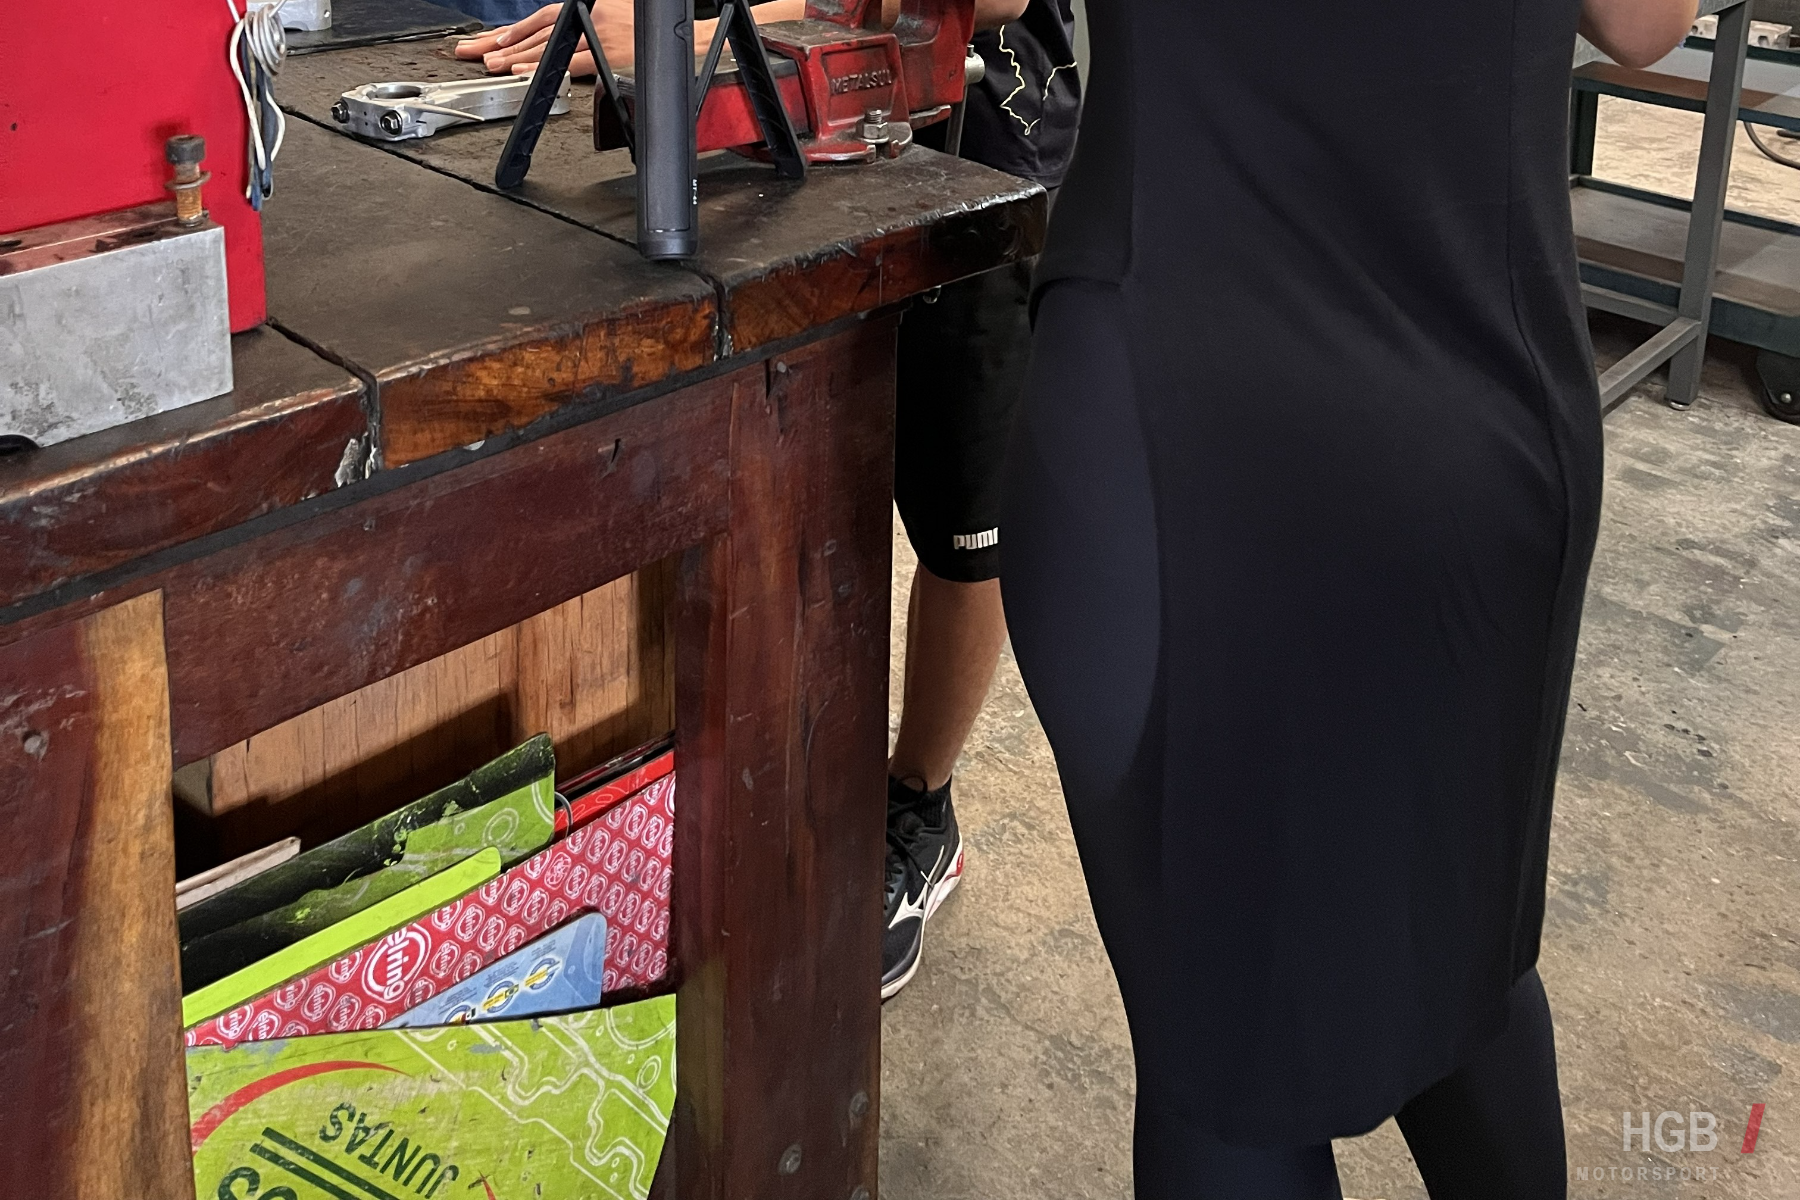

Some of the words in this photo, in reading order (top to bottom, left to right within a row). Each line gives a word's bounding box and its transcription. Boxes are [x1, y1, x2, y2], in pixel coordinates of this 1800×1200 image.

[830, 69, 892, 95] METALSUL
[384, 927, 410, 1000] elring
[319, 1102, 460, 1199] JUNTAS
